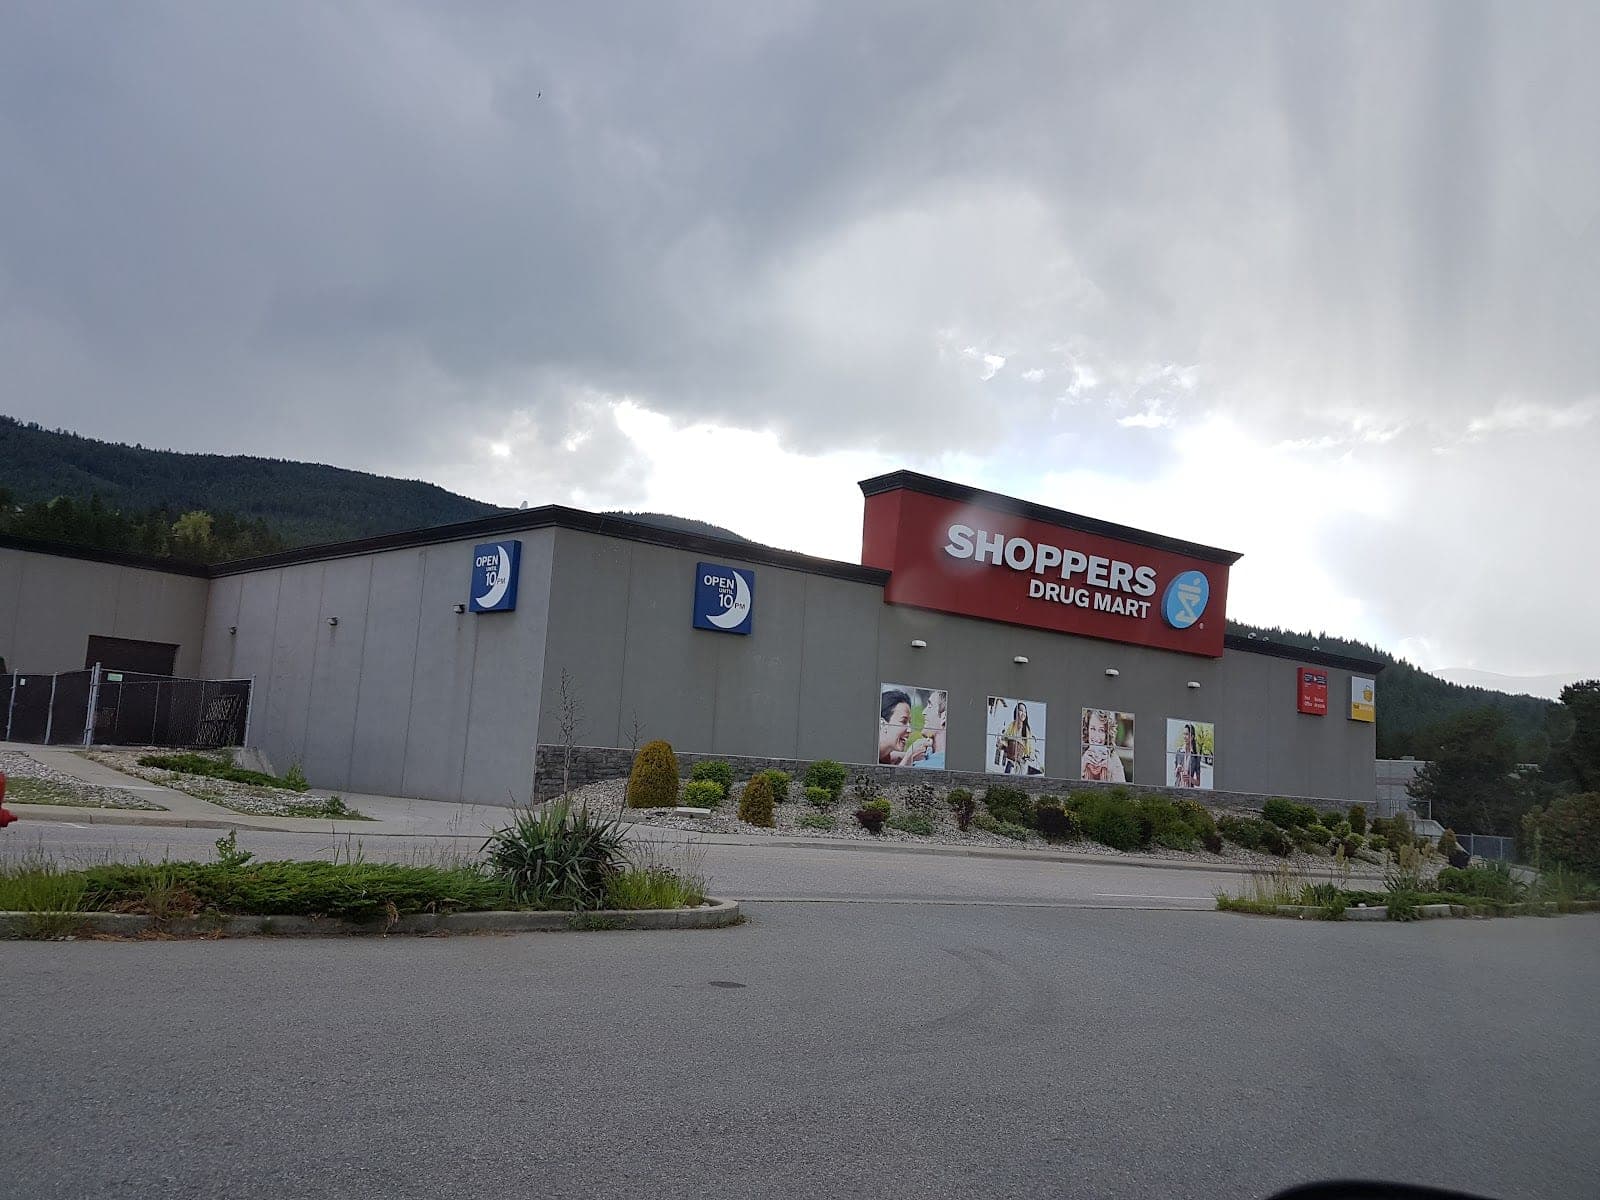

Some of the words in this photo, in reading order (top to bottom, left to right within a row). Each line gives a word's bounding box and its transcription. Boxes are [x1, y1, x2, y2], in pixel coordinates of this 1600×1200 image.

[476, 555, 498, 567] OPEN
[944, 524, 1157, 597] SHOPPERS
[704, 575, 734, 589] OPEN
[1029, 579, 1089, 608] DRUG
[1093, 592, 1151, 619] MART
